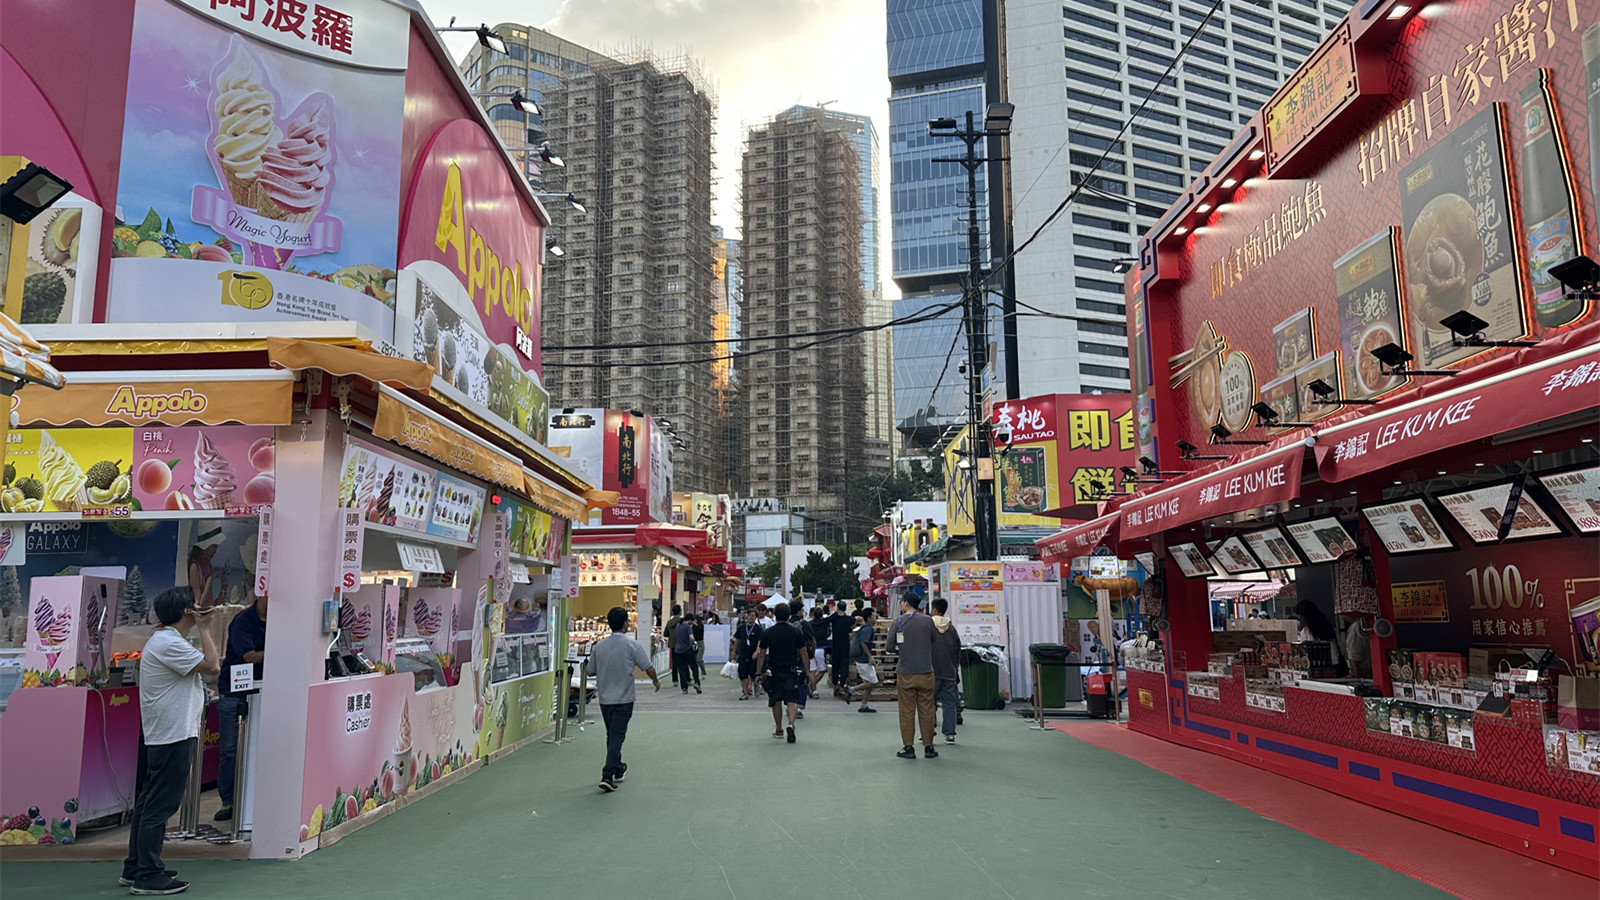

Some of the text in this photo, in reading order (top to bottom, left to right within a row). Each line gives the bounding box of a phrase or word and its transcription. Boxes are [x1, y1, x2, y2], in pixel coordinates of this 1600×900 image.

[1284, 58, 1333, 125] 李錦記
[1286, 90, 1334, 145] LEE KUM KEE
[1474, 140, 1504, 267] 花膠鮑魚
[227, 210, 313, 245] Magic Yogurt
[1210, 178, 1328, 299] 即食極品鮑魚
[435, 159, 532, 335] Appolo
[276, 301, 291, 309] Hong
[292, 304, 306, 312] Kong
[307, 306, 317, 314] Top
[317, 308, 332, 317] Brand
[276, 307, 327, 322] Achievement Award
[107, 386, 206, 416] Appolo
[403, 410, 434, 445] Appolo
[559, 417, 586, 427] 南北行
[1375, 396, 1482, 450] LEE KUM KEE
[143, 431, 163, 442] 白桃
[143, 439, 174, 456] Peach
[1334, 431, 1371, 464] 李錦記
[450, 434, 475, 464] Appolo
[622, 435, 633, 476] 南北行
[1224, 464, 1286, 499] LEE KUM KEE
[1199, 484, 1221, 506] 李錦記
[109, 505, 130, 518] $55
[612, 508, 641, 517] 1848-55
[1126, 511, 1143, 528] 李錦記
[1144, 497, 1180, 523] LEE KUM KEE
[28, 521, 82, 535] Appolo
[343, 512, 360, 562] 購票處
[26, 535, 81, 551] GALAXY
[1400, 589, 1433, 607] 李錦記
[1466, 564, 1544, 610] 100%
[1401, 608, 1433, 616] LEE KUM KEE
[1472, 618, 1546, 637] 用家信心推薦
[346, 692, 372, 713] 購票處
[346, 715, 371, 732] Cashier
[204, 728, 220, 743] App
